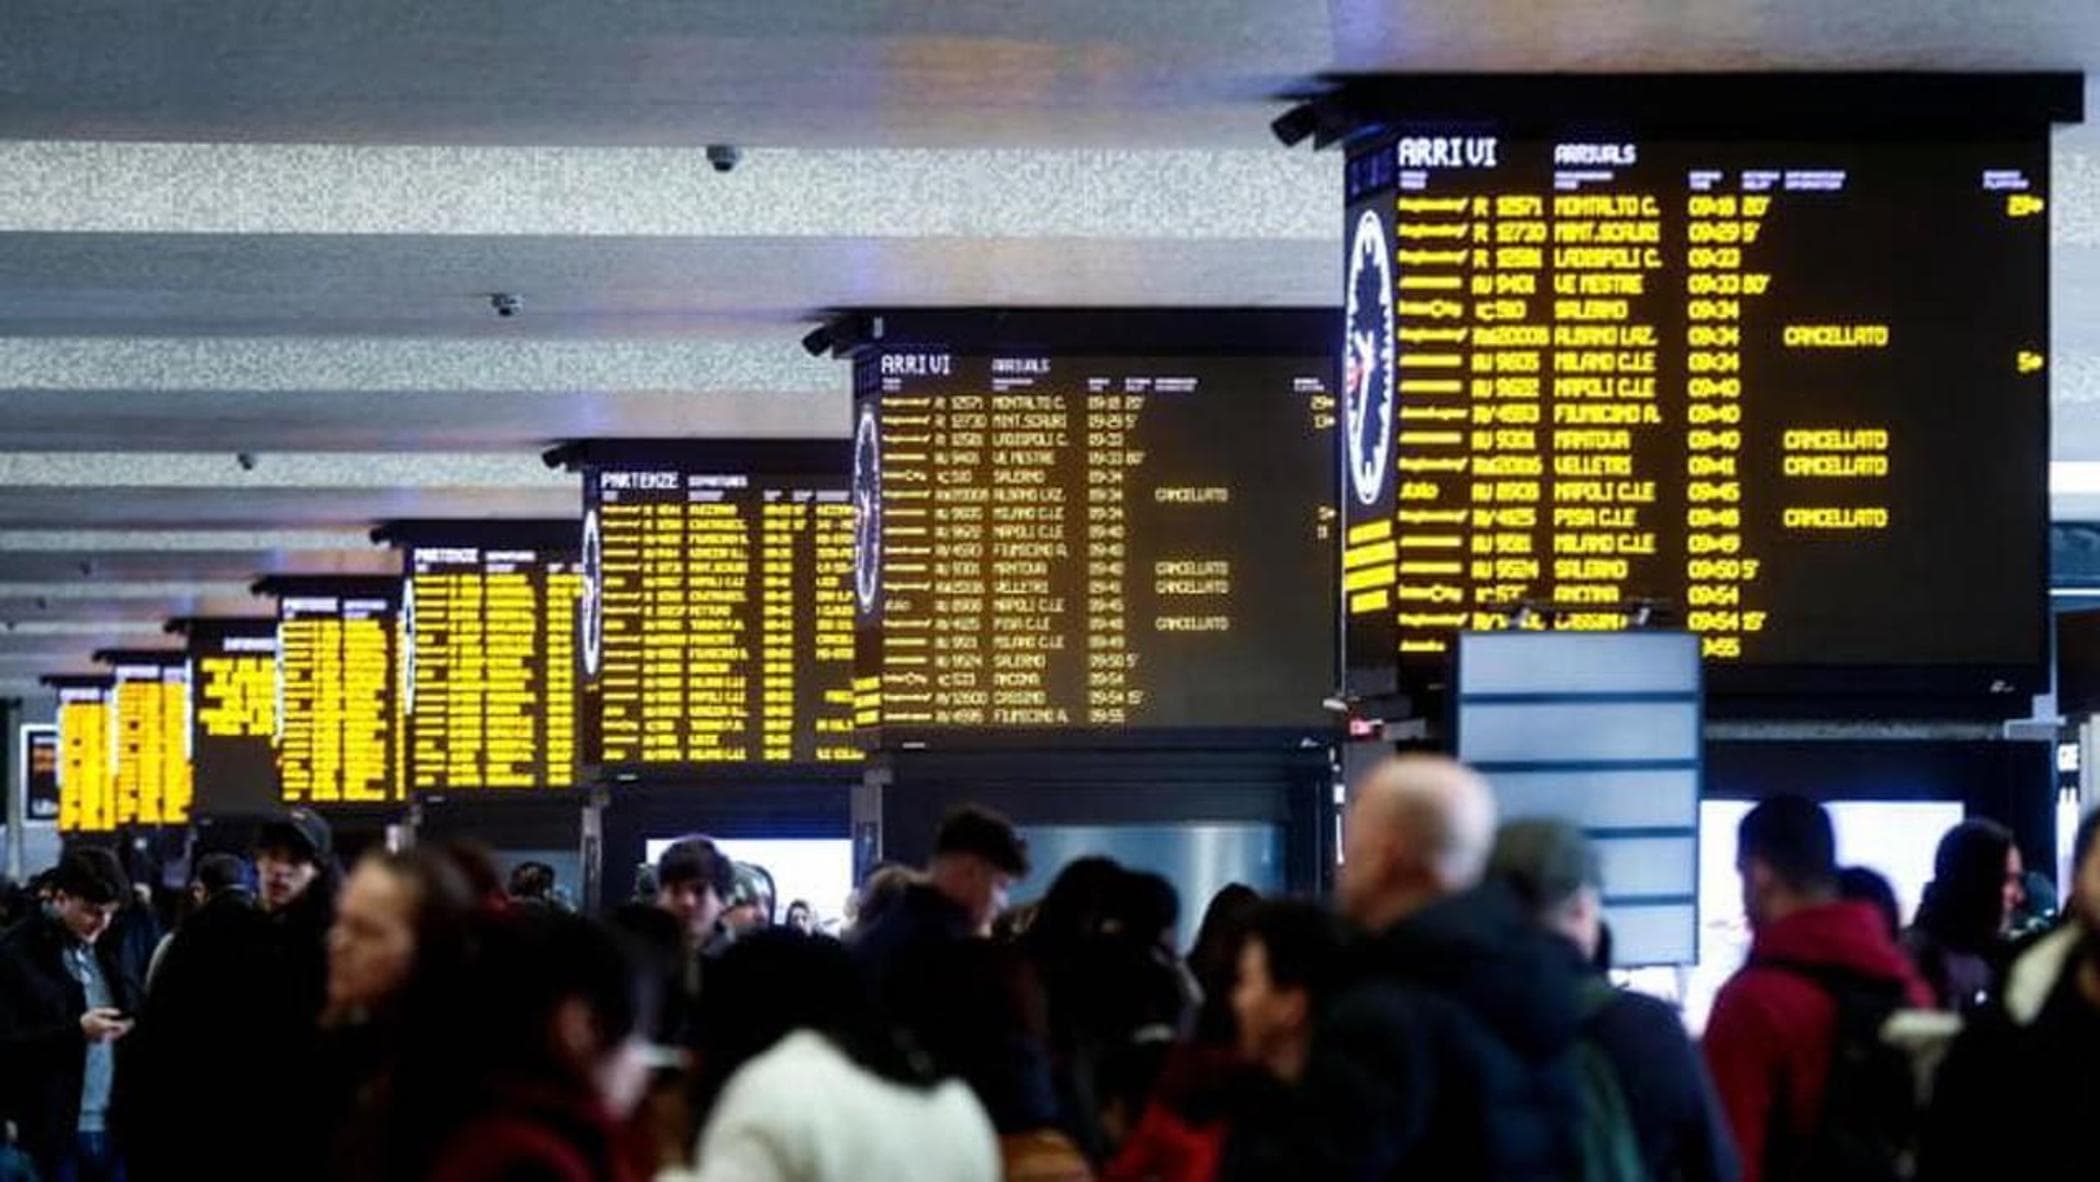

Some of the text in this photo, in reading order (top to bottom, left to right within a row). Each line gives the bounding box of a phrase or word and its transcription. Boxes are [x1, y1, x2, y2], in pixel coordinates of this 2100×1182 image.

[1399, 138, 1497, 167] ARRIVI
[1784, 326, 1888, 346] CANCELLATO
[881, 355, 950, 375] ARRIVI
[1784, 430, 1887, 449] CANCELLATO
[1784, 456, 1887, 475] CANCELLATO
[601, 472, 680, 489] PARTENZE
[1784, 508, 1887, 527] CANCELLATO
